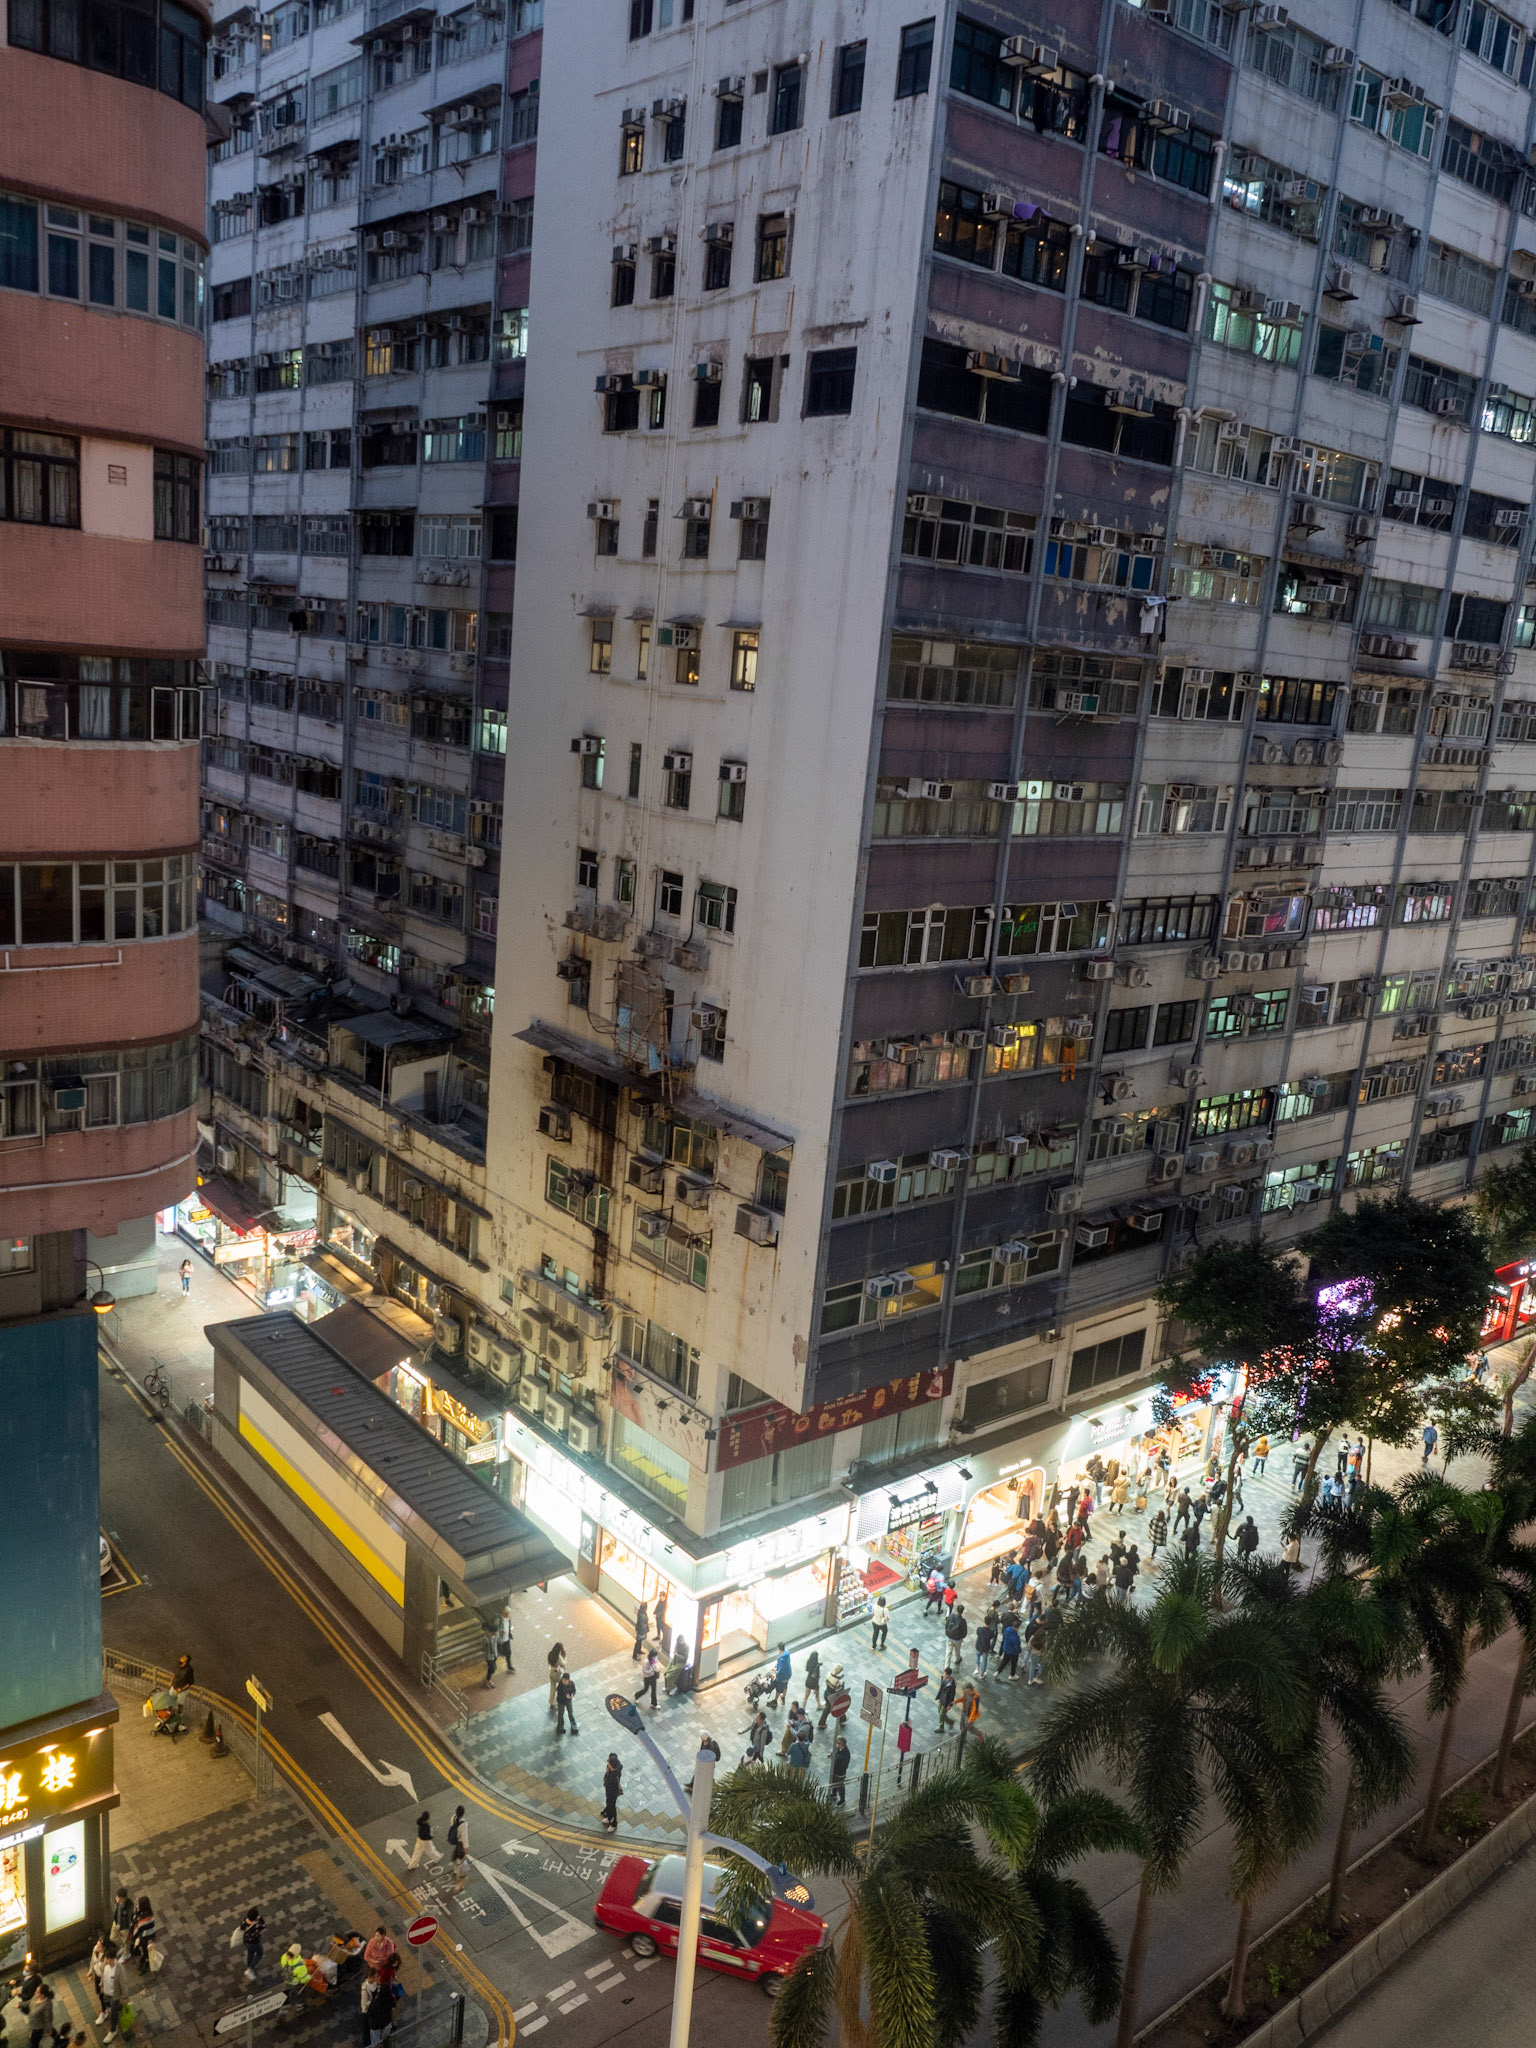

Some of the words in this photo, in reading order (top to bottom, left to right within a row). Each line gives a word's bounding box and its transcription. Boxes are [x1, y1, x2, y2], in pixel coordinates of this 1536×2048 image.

[541, 1858, 593, 1881] RIGHT
[453, 1890, 487, 1920] LEFT
[234, 2007, 255, 2018] Nathan
[256, 2000, 270, 2009] Road
